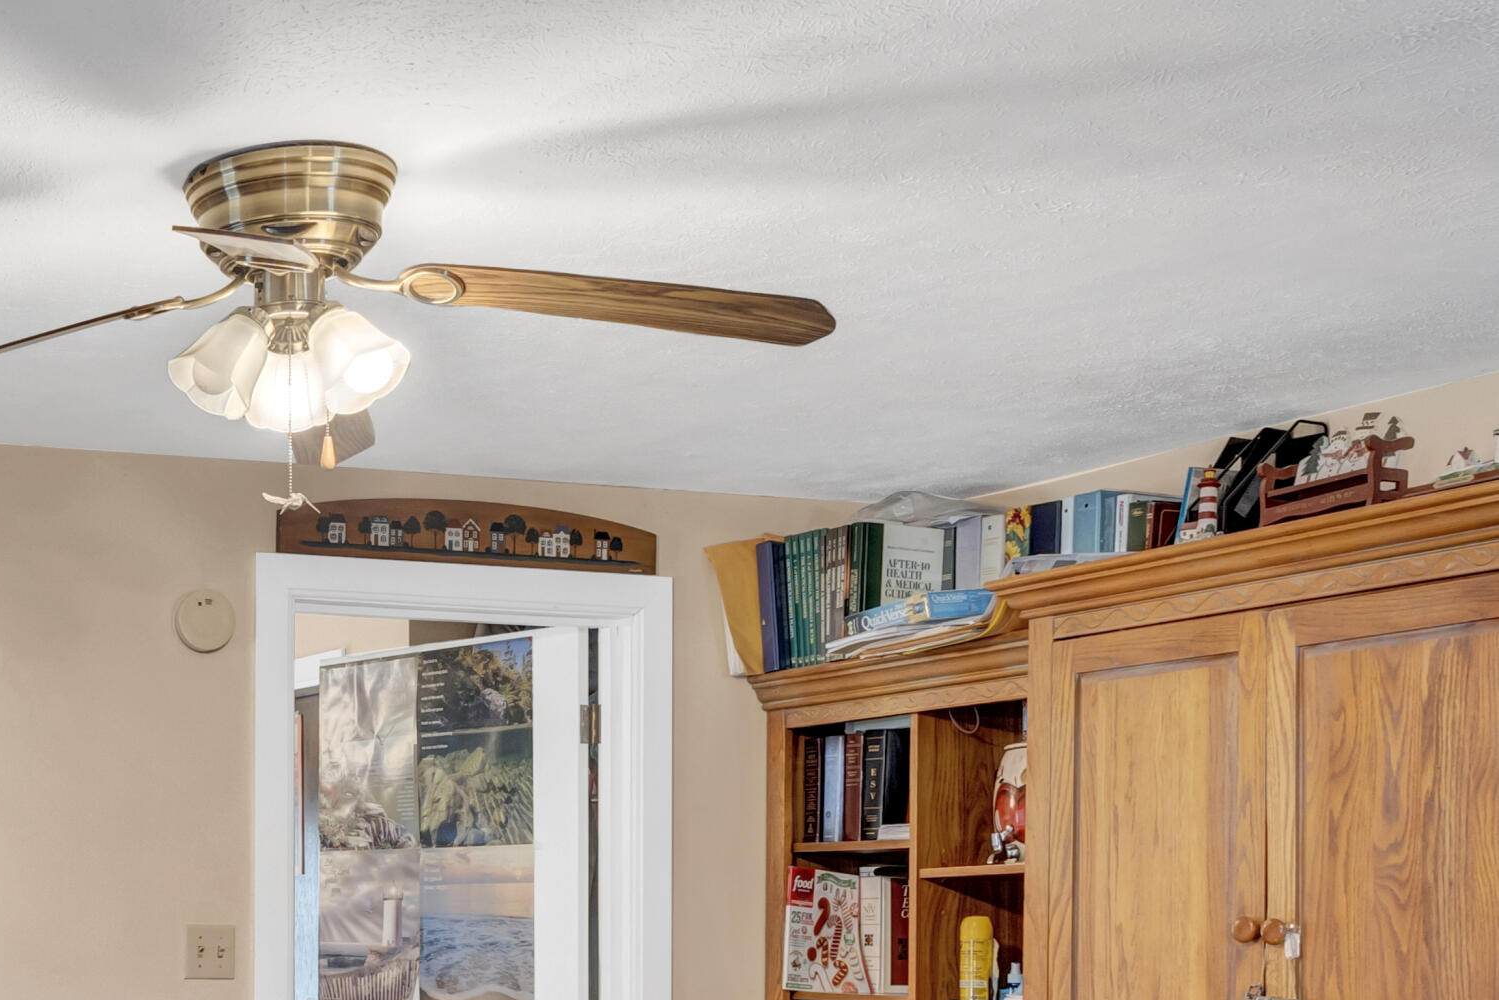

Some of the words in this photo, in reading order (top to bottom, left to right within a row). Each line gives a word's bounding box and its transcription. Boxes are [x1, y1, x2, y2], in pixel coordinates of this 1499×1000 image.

[887, 559, 931, 570] AFTER-40
[886, 568, 922, 580] HEALTH
[885, 579, 892, 588] &
[894, 580, 934, 592] MEDICAL
[792, 875, 814, 892] food
